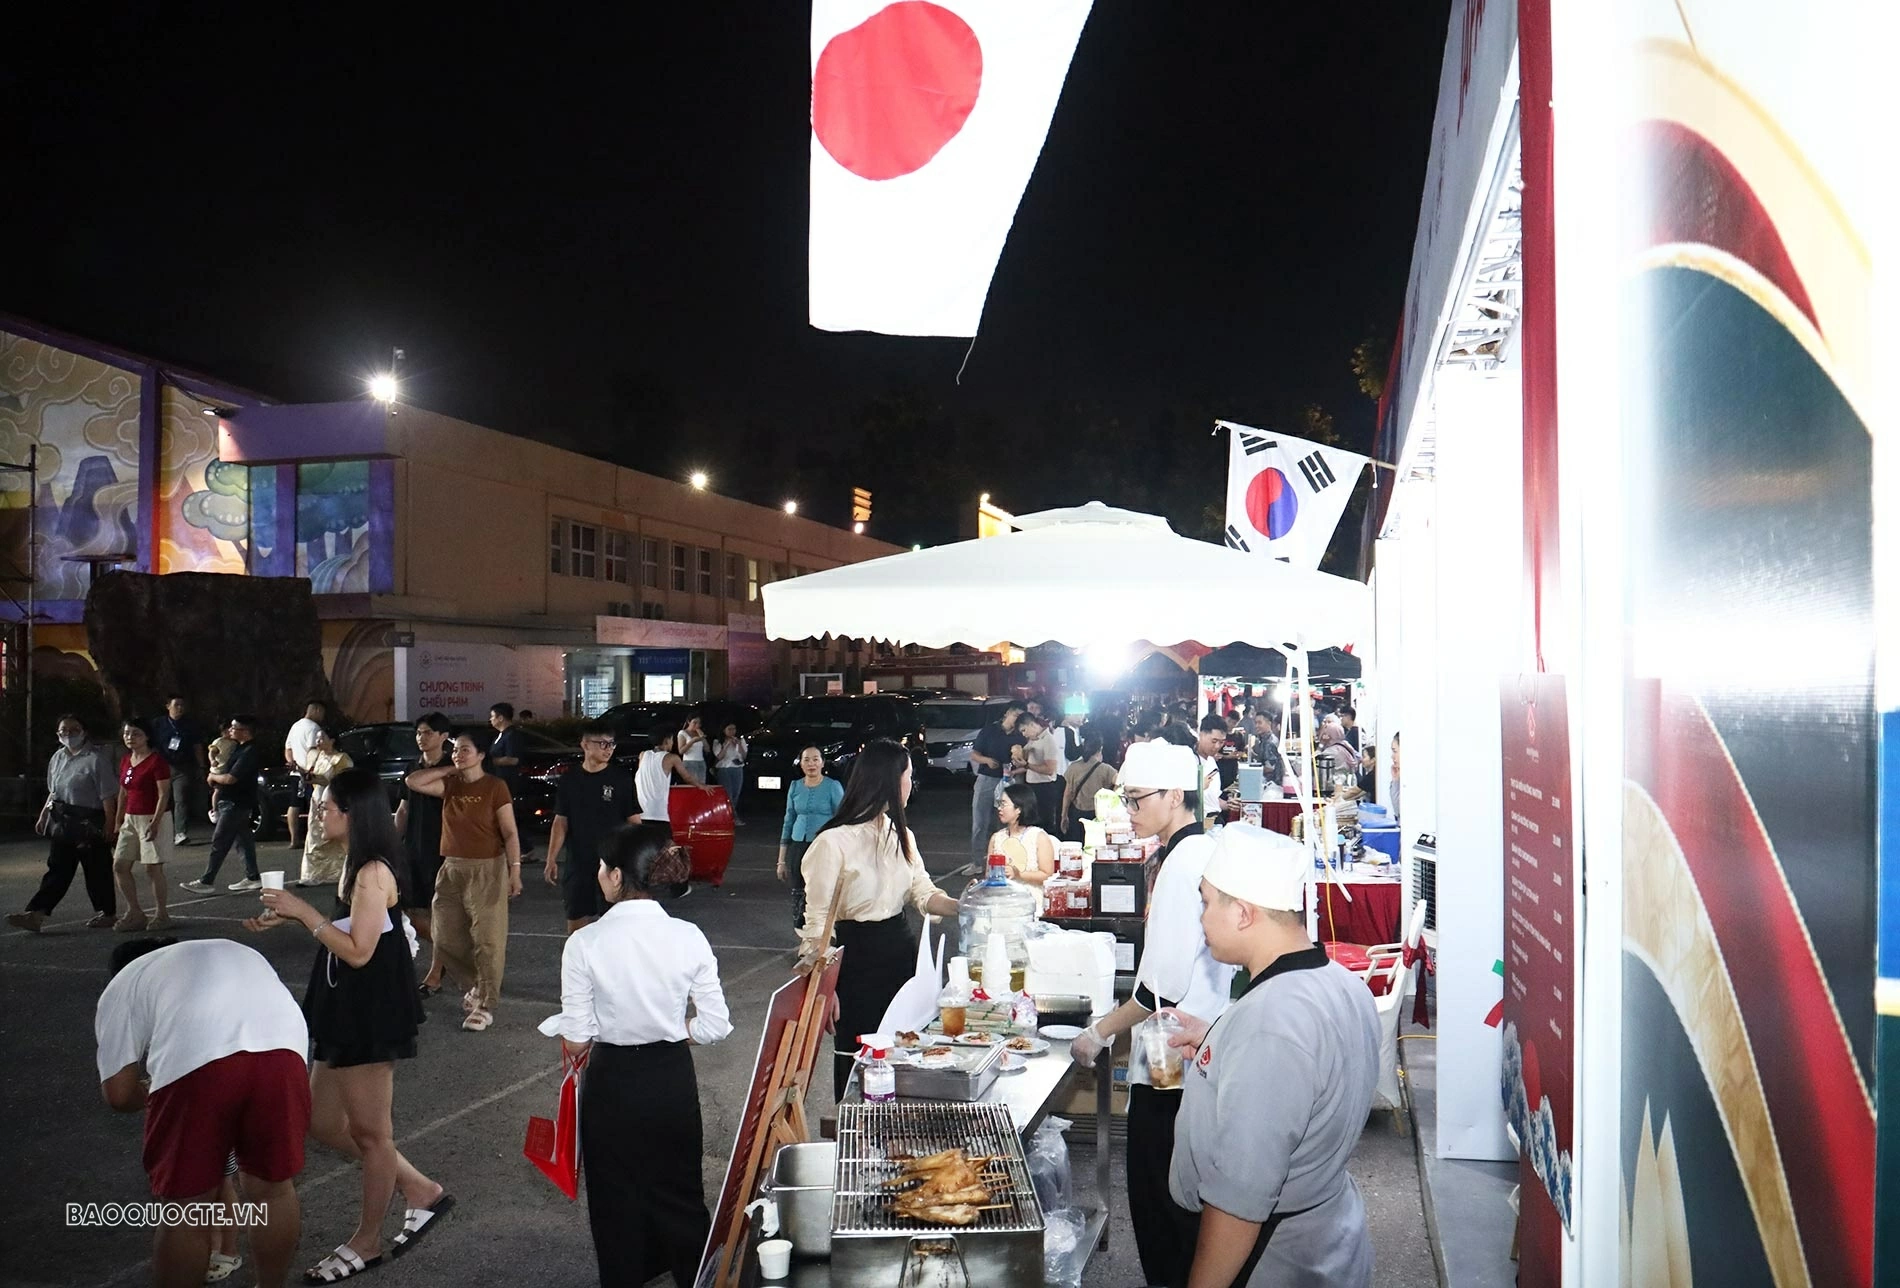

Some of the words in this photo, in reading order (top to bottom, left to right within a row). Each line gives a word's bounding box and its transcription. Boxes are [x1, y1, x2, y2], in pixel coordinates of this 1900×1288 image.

[419, 681, 459, 692] CHƯƠNG
[460, 680, 484, 692] TRÌNH
[419, 694, 446, 708] CHIẾU
[447, 697, 468, 708] PHIM
